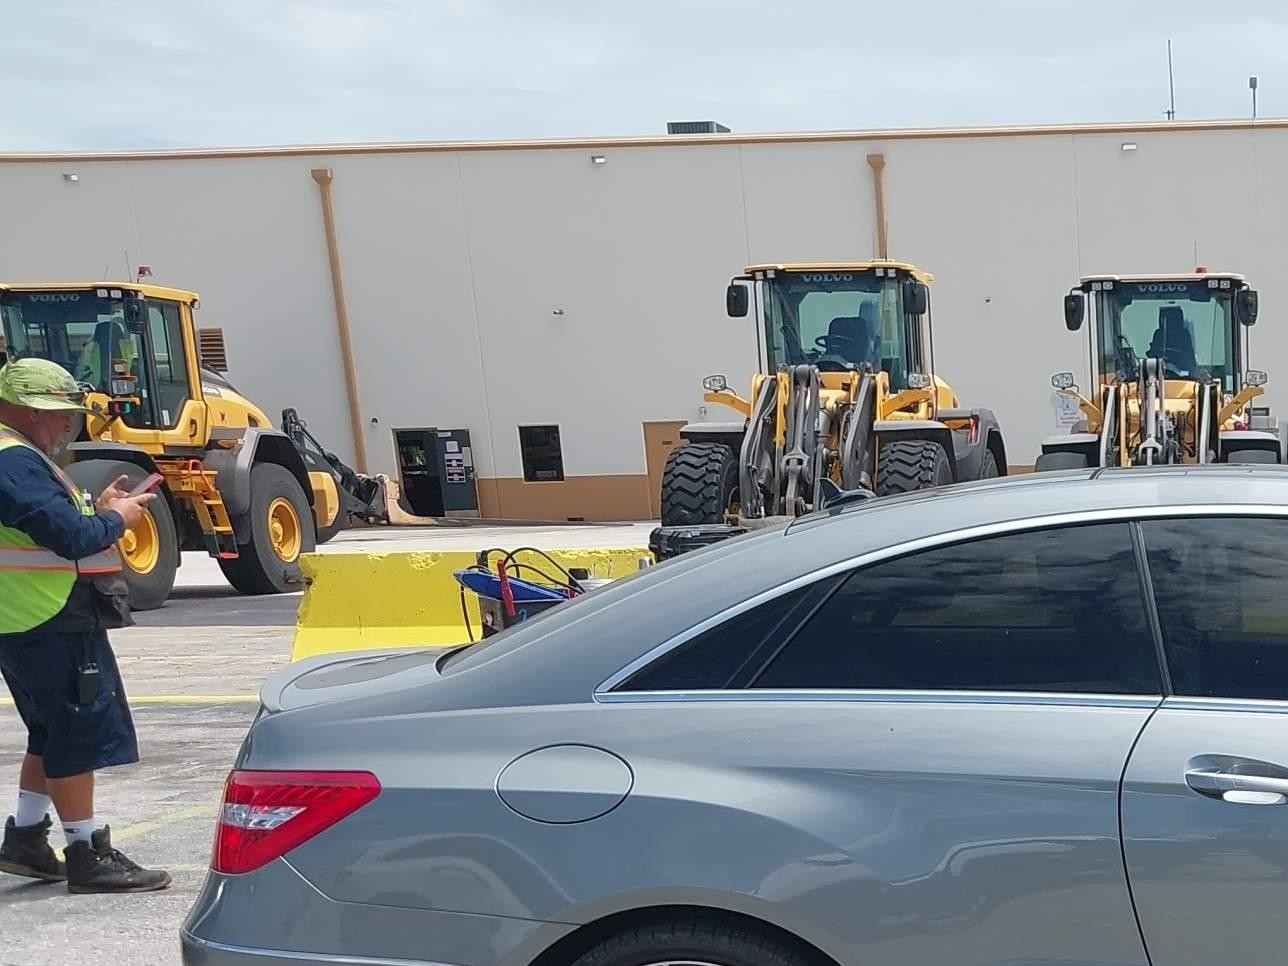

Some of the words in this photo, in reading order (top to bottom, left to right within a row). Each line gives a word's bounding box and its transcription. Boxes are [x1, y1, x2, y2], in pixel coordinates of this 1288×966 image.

[801, 272, 853, 282] VOLVO
[1138, 283, 1187, 292] VOLVO
[30, 293, 80, 302] VOLVO
